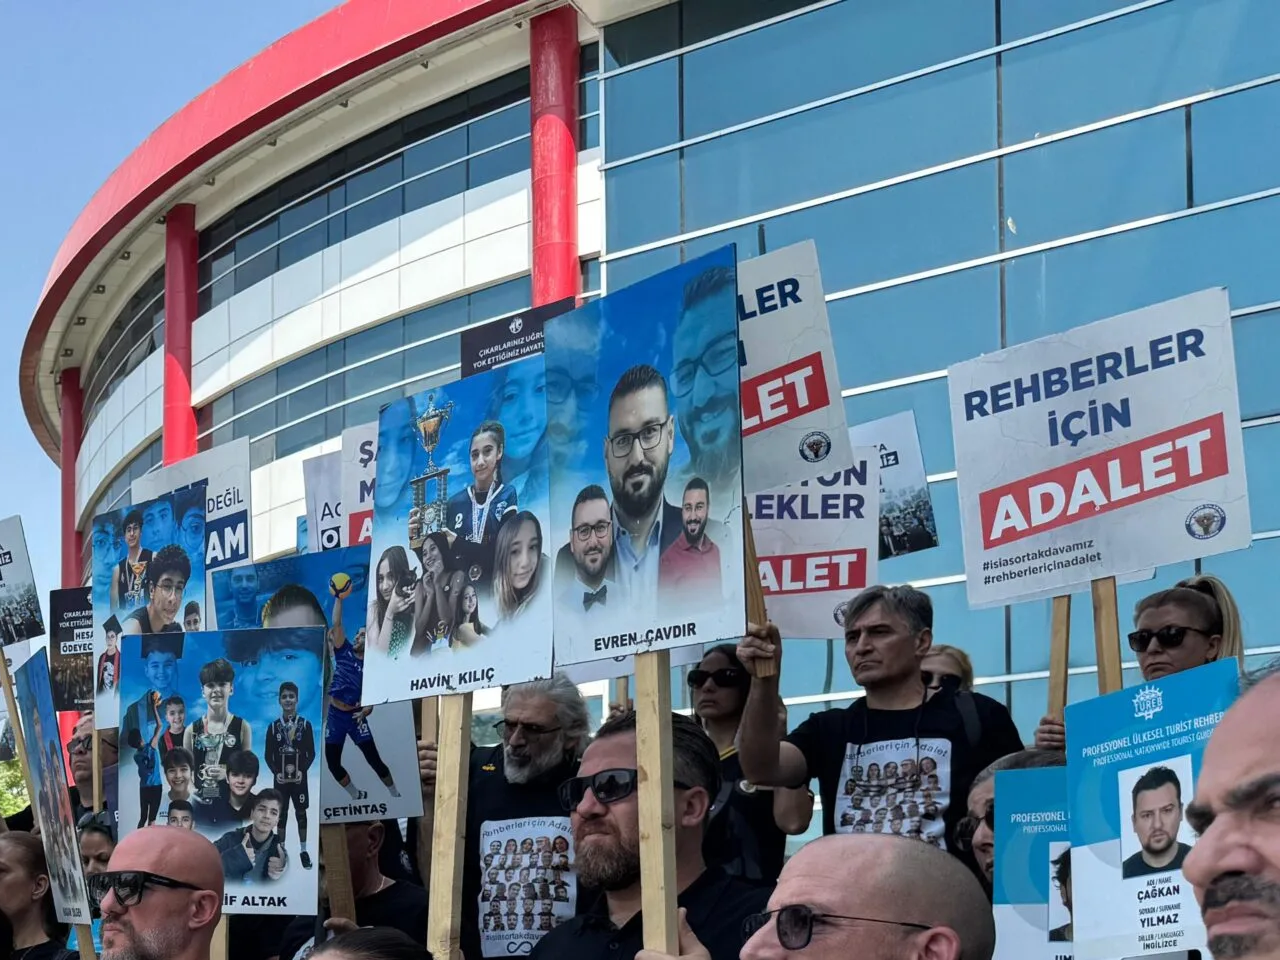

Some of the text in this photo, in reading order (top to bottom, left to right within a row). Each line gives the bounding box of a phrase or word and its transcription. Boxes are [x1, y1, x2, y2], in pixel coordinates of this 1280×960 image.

[473, 358, 486, 369] YOK
[488, 350, 520, 364] ETTİĞİNİZ
[479, 338, 524, 357] ÇIKARLARINIZ
[964, 328, 1206, 421] REHBERLER
[1048, 397, 1131, 447] İÇİN
[989, 428, 1211, 541] ADALET
[207, 487, 244, 513] DEĞİL
[749, 494, 865, 520] EKLER
[983, 539, 1094, 571] #isiasortakdavamız
[983, 551, 1102, 585] #rehberleriçinadalet
[593, 622, 697, 652] EVREN ÇAVDIR
[410, 667, 495, 691] HAVİN KILIÇ
[1082, 736, 1132, 758] PROFESYONEL
[1133, 727, 1164, 745] ÜLKESEL
[1166, 719, 1193, 736] TURİST
[1093, 747, 1134, 767] PROFESSIONAL
[1171, 734, 1195, 748] TOURIST
[323, 803, 388, 819] ÇETİNTAŞ
[1010, 811, 1066, 823] PROFESYONEL
[1023, 824, 1068, 834] PROFESSIONAL
[241, 896, 287, 908] ALTAK
[1137, 884, 1180, 903] ÇAĞKAN
[1140, 913, 1179, 928] YILMAZ
[1143, 939, 1178, 950] İNGİLİZCE
[1158, 930, 1184, 940] LANGUAGES
